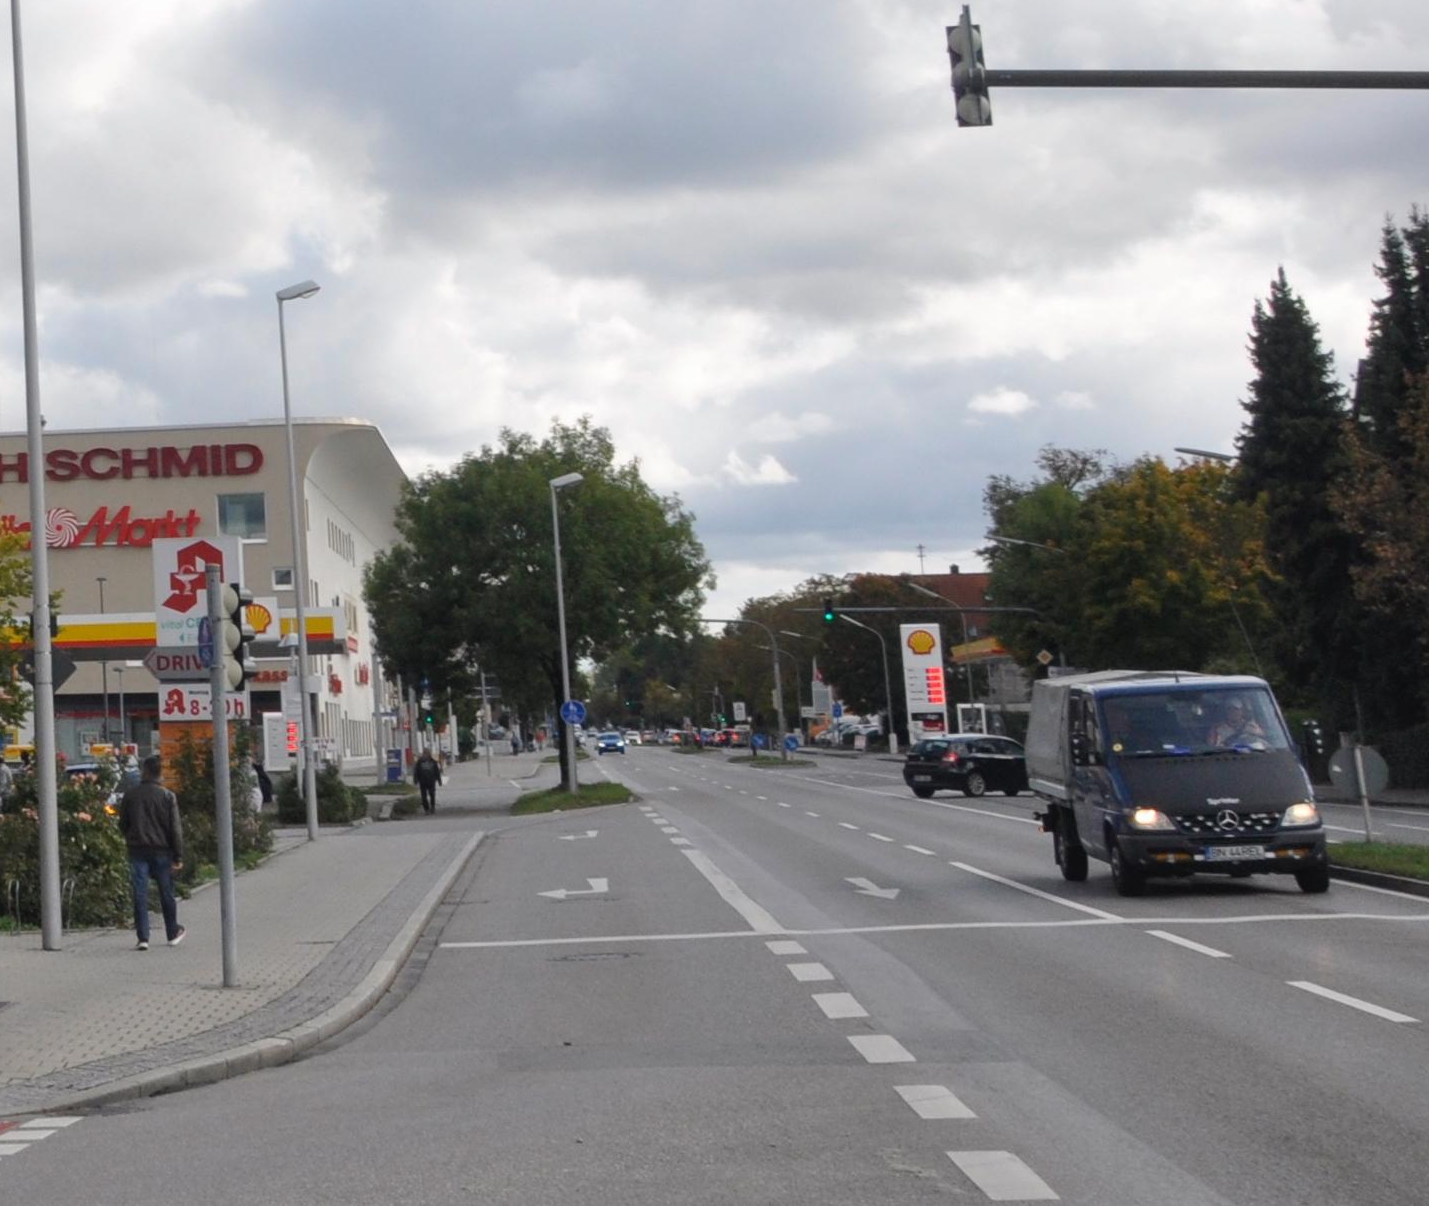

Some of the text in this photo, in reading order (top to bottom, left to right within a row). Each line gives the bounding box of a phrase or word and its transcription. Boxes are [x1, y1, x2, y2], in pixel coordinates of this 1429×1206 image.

[45, 442, 264, 481] SCHMID
[73, 505, 202, 549] Markt
[156, 654, 203, 671] DRIV
